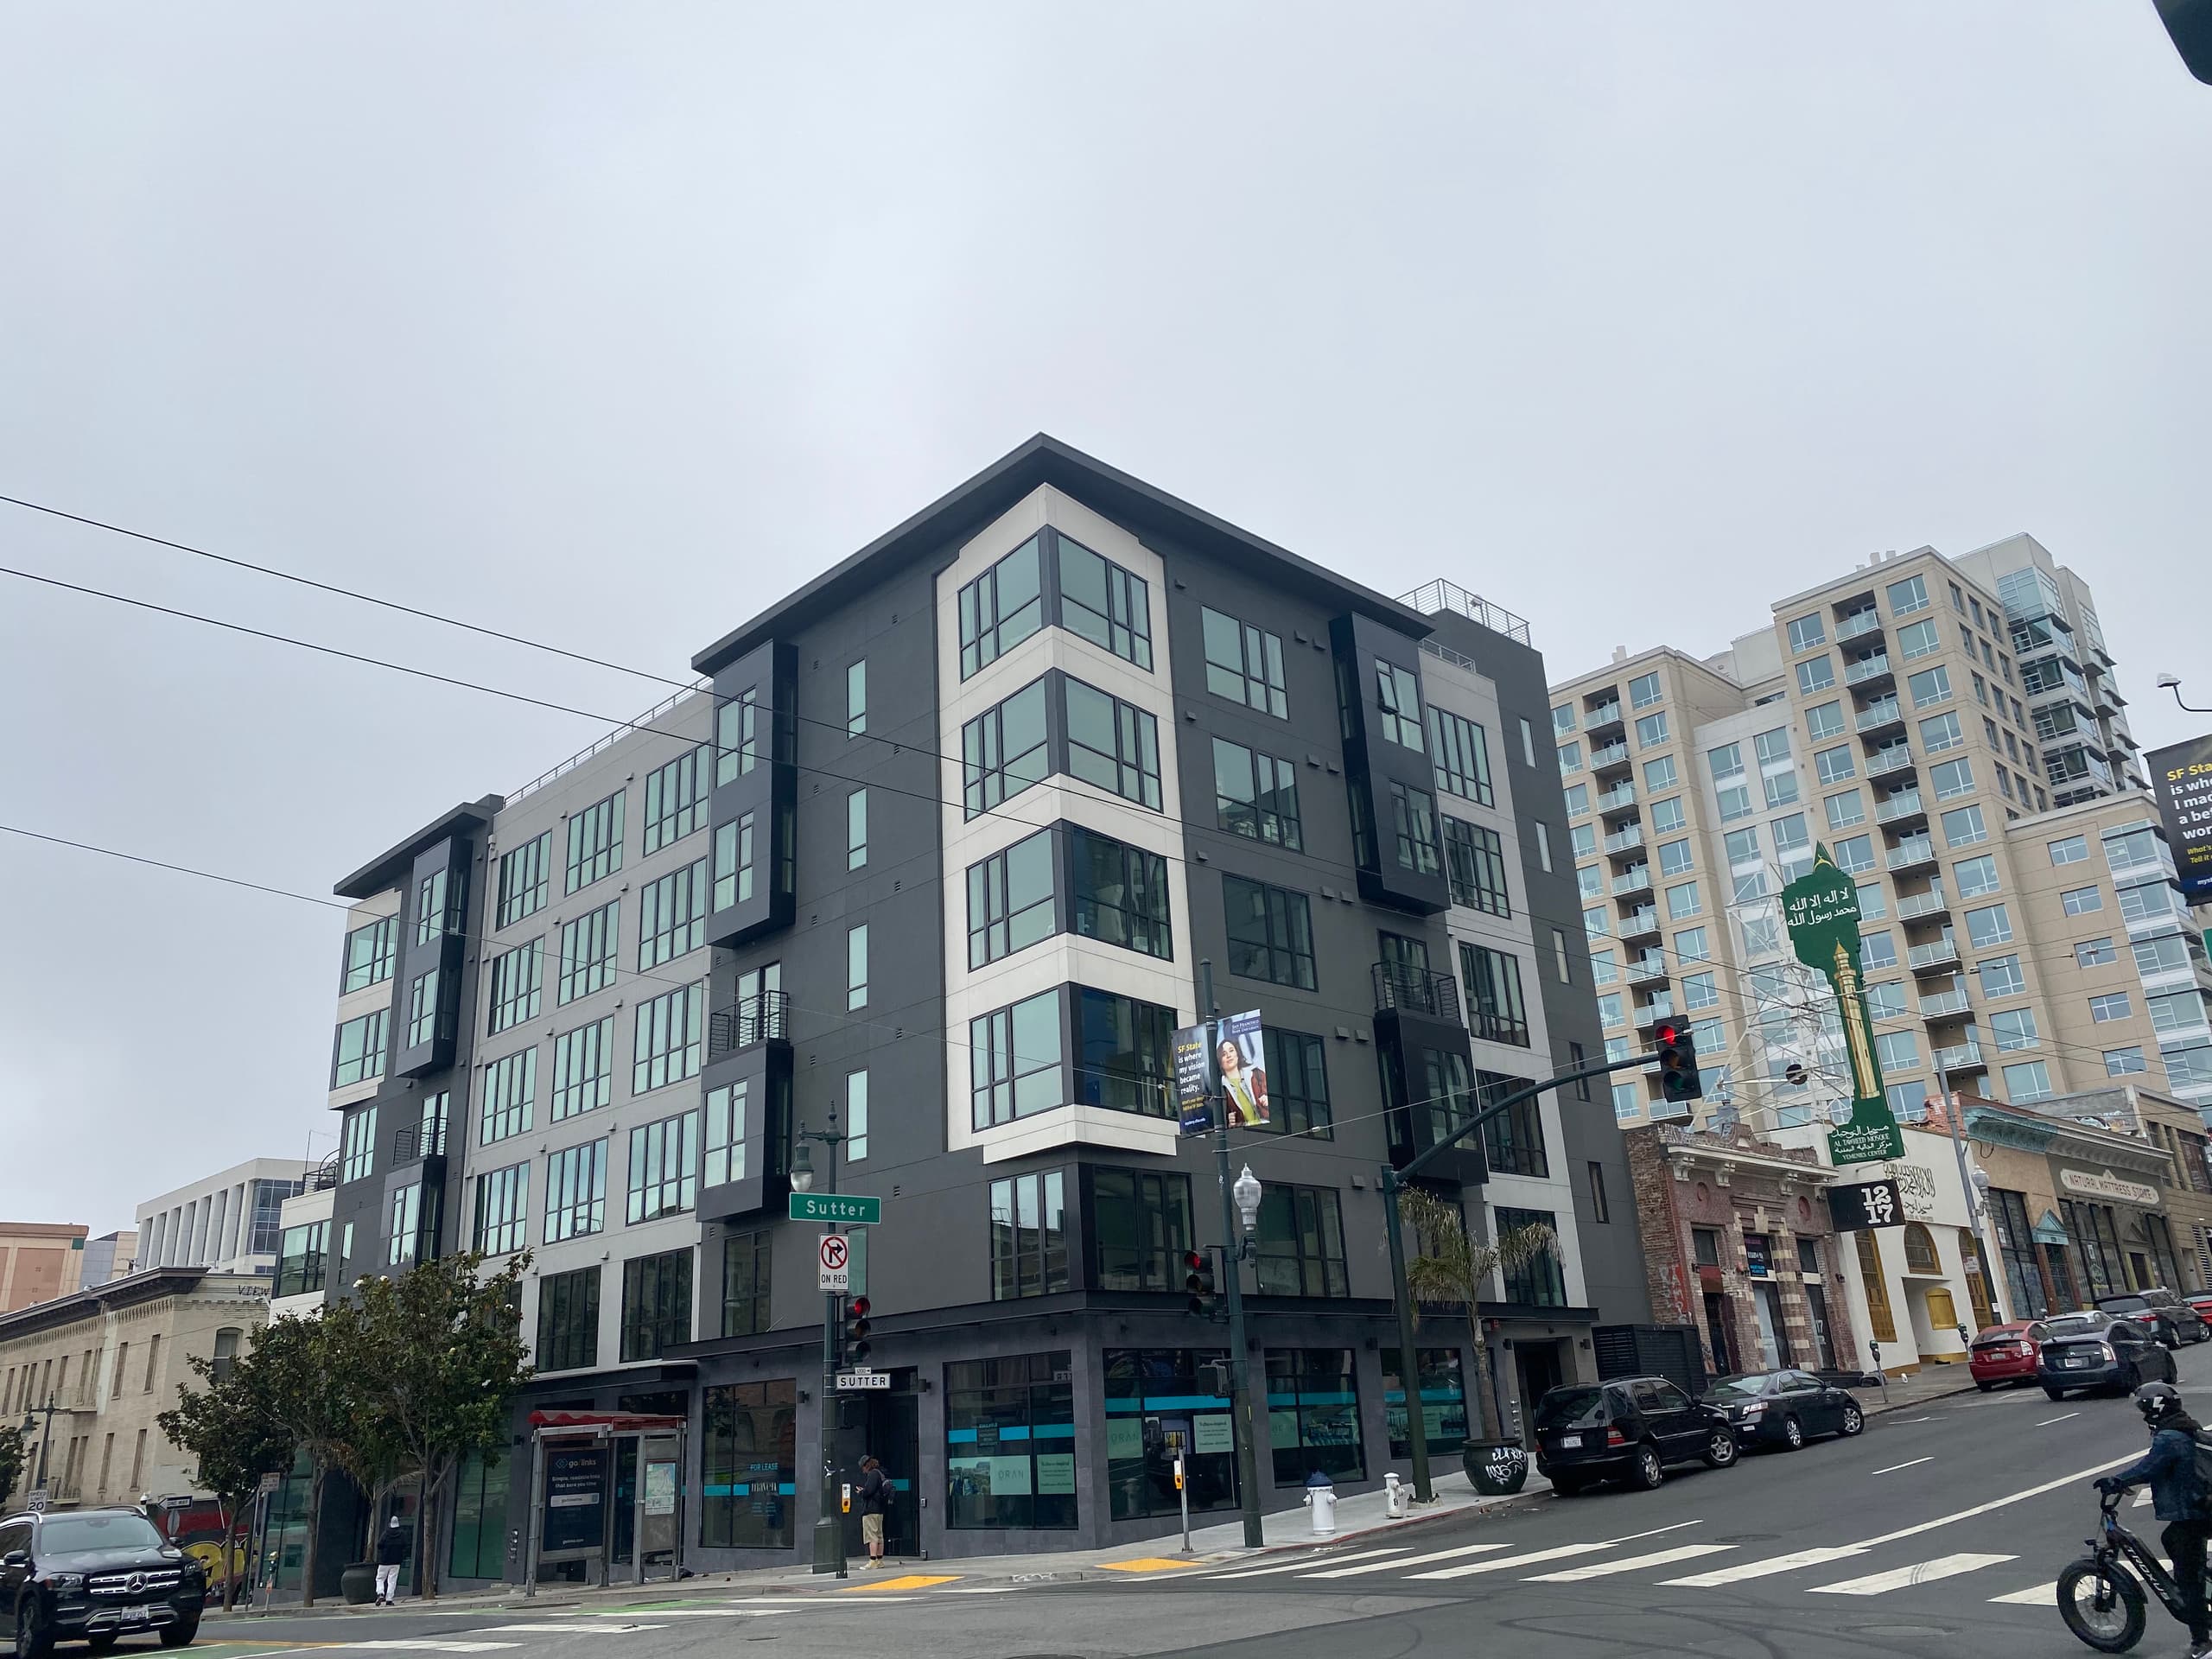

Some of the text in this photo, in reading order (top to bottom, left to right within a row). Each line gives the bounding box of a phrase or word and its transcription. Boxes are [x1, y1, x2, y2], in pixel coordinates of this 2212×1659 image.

[2167, 768, 2184, 781] SF
[2170, 785, 2183, 796] is
[2174, 799, 2180, 810] I
[2178, 816, 2189, 825] a
[2190, 855, 2202, 864] Tell
[1839, 887, 1849, 899] لا
[1834, 906, 1857, 917] محمد
[1808, 910, 1832, 925] رسول
[1178, 1041, 1202, 1053] SF State
[1184, 1052, 1202, 1062] where
[1179, 1061, 1205, 1075] my vision
[1179, 1072, 1201, 1084] became
[1180, 1084, 1200, 1095] reality.
[1862, 1125, 1890, 1136] مسجد
[1866, 1133, 1891, 1143] MOSQUE
[2069, 1174, 2152, 1200] NATURAL MATTRESS STORE
[1861, 1185, 1891, 1206] 12
[806, 1199, 865, 1217] Sutter
[1866, 1203, 1893, 1224] 17
[821, 1274, 848, 1284] ON RED
[840, 1376, 886, 1387] SUTTER
[761, 1462, 779, 1471] LEASE
[27, 1502, 44, 1511] 20
[2126, 1546, 2171, 1600] TROXUS
